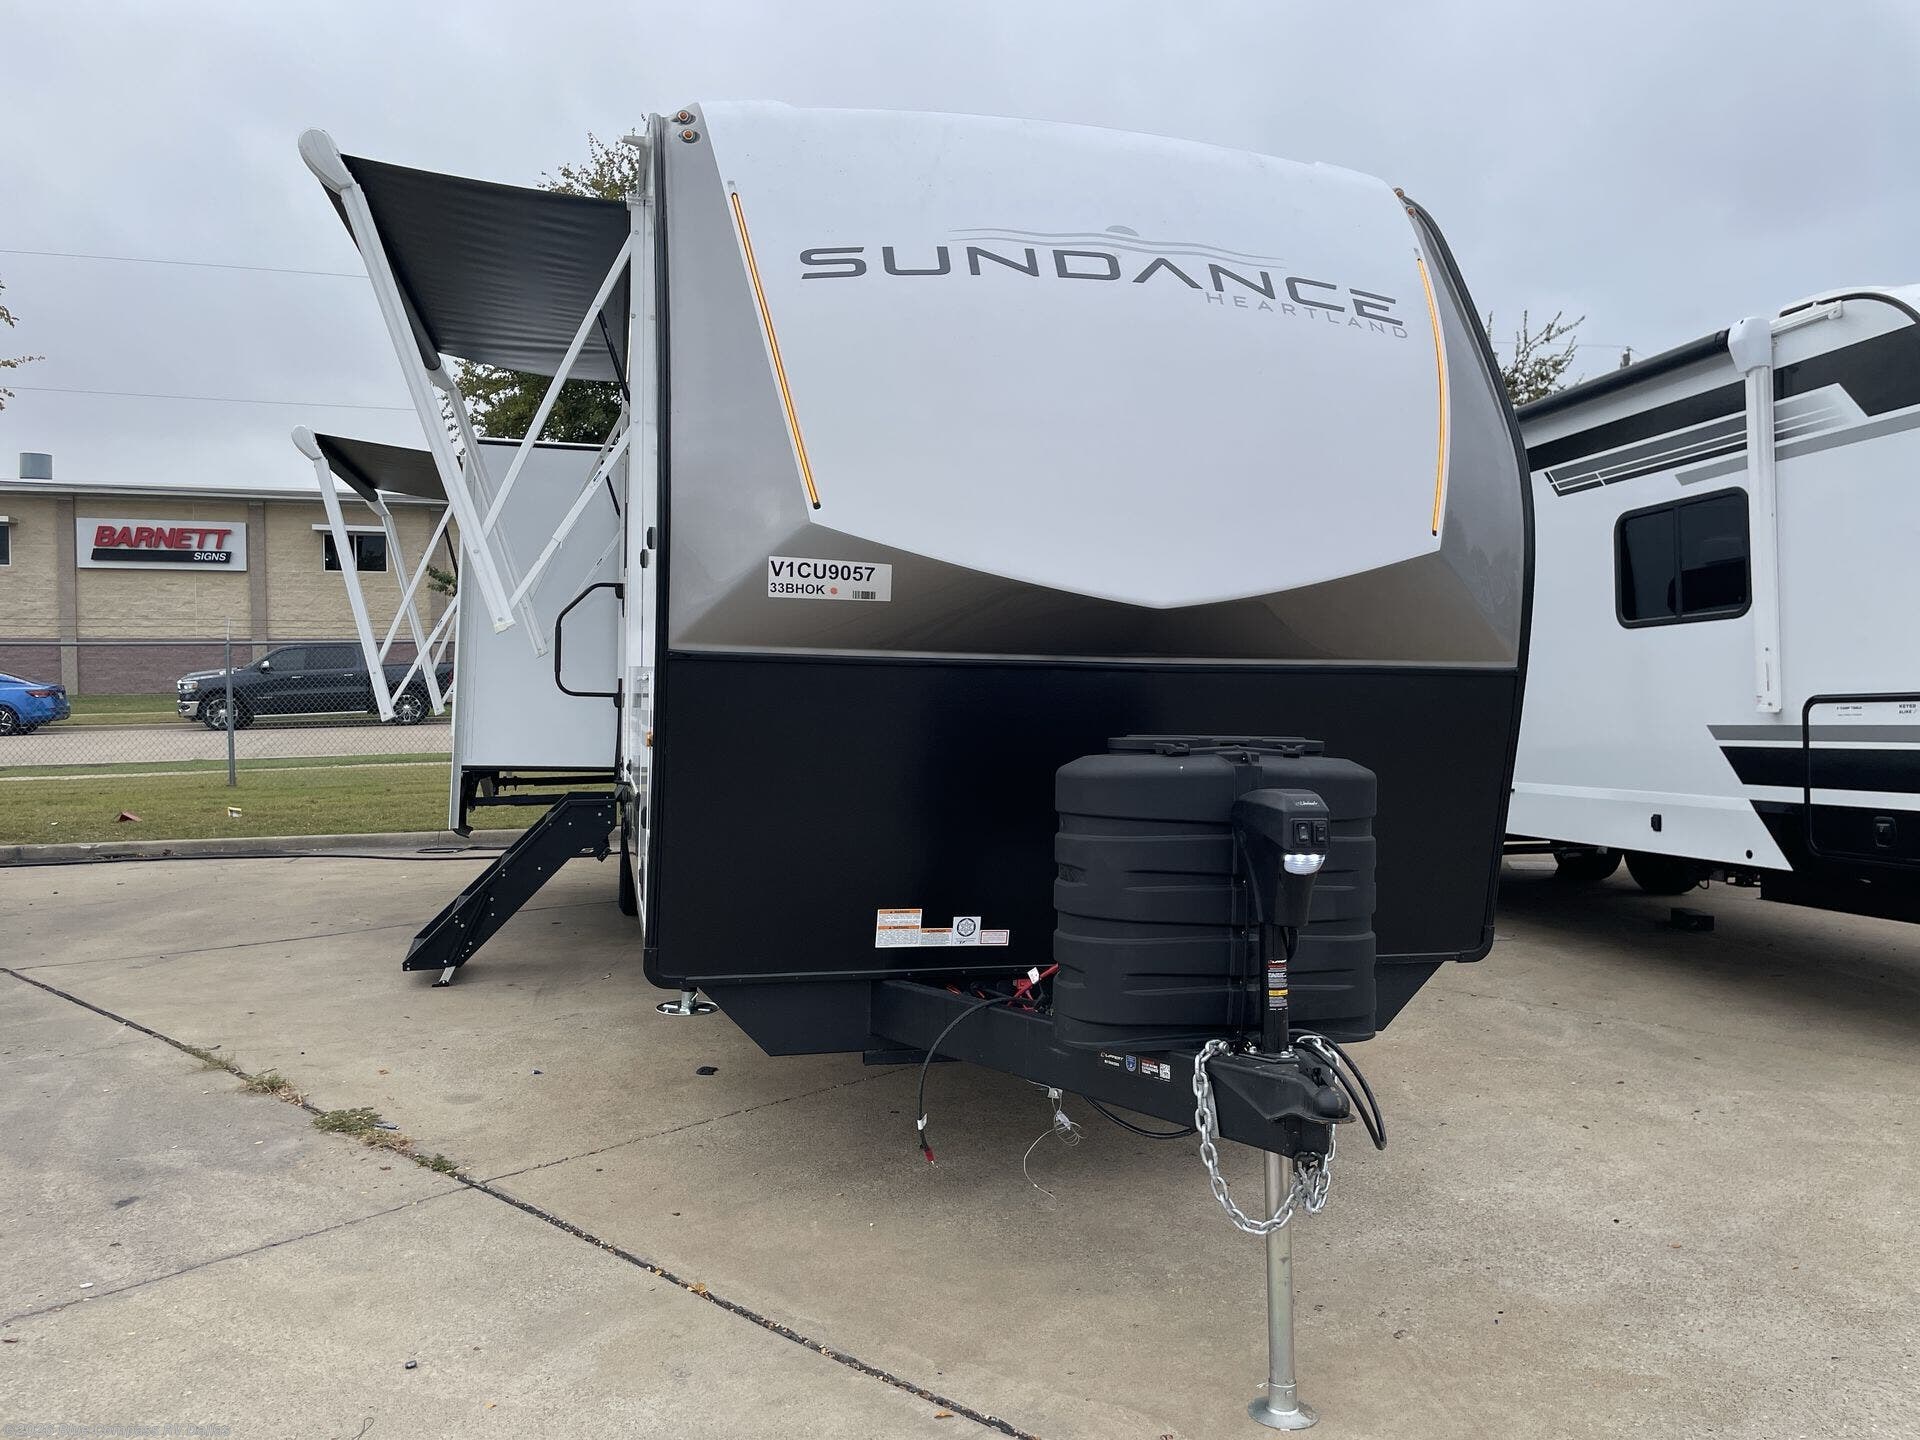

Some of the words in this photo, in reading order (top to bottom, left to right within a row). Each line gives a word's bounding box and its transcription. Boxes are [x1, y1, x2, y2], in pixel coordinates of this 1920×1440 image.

[799, 246, 1404, 327] SUNDANCE
[1206, 290, 1409, 340] HEARTLAND
[94, 525, 232, 550] BARNETT
[193, 551, 227, 562] SIGNS
[770, 560, 876, 582] V1CU9057
[769, 582, 826, 595] 33BHOK
